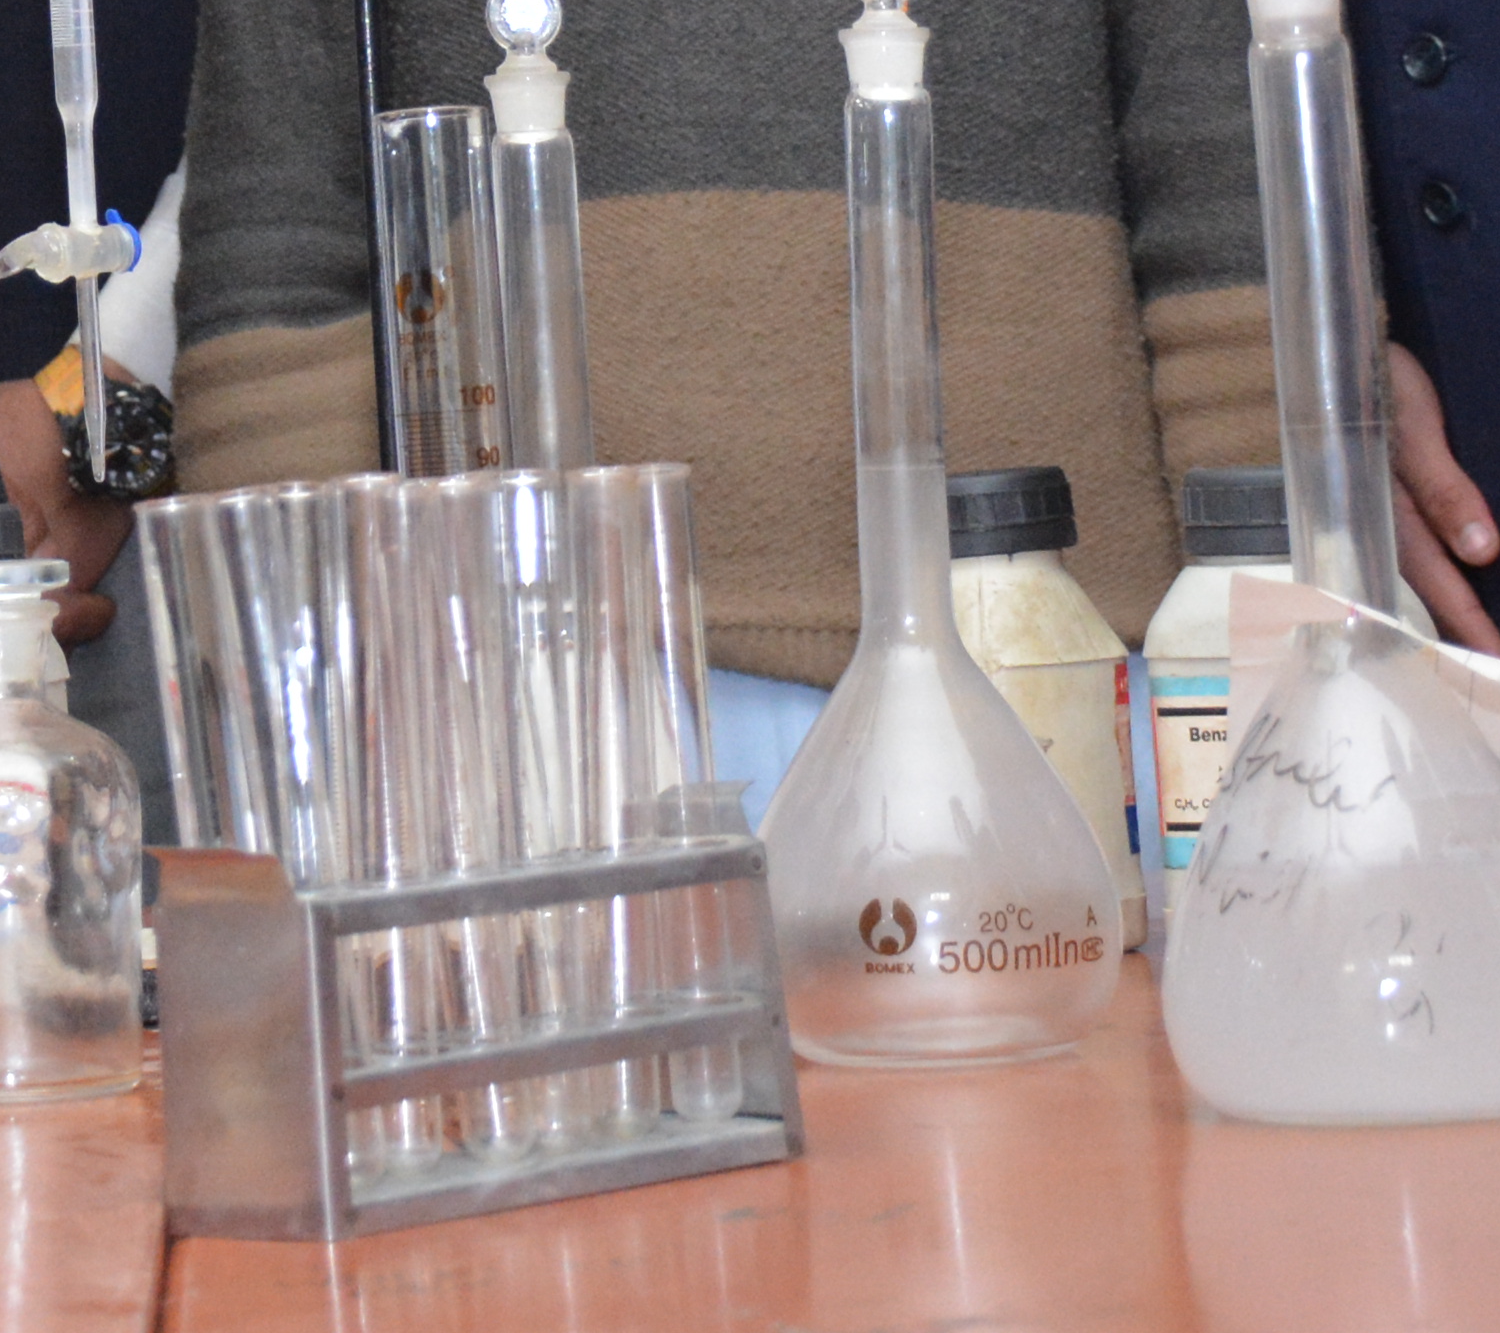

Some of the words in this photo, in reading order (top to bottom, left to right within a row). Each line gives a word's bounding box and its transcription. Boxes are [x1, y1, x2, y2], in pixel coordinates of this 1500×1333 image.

[460, 385, 496, 406] 100
[477, 445, 500, 468] 90
[1086, 905, 1098, 928] A
[865, 962, 916, 974] BOMEX
